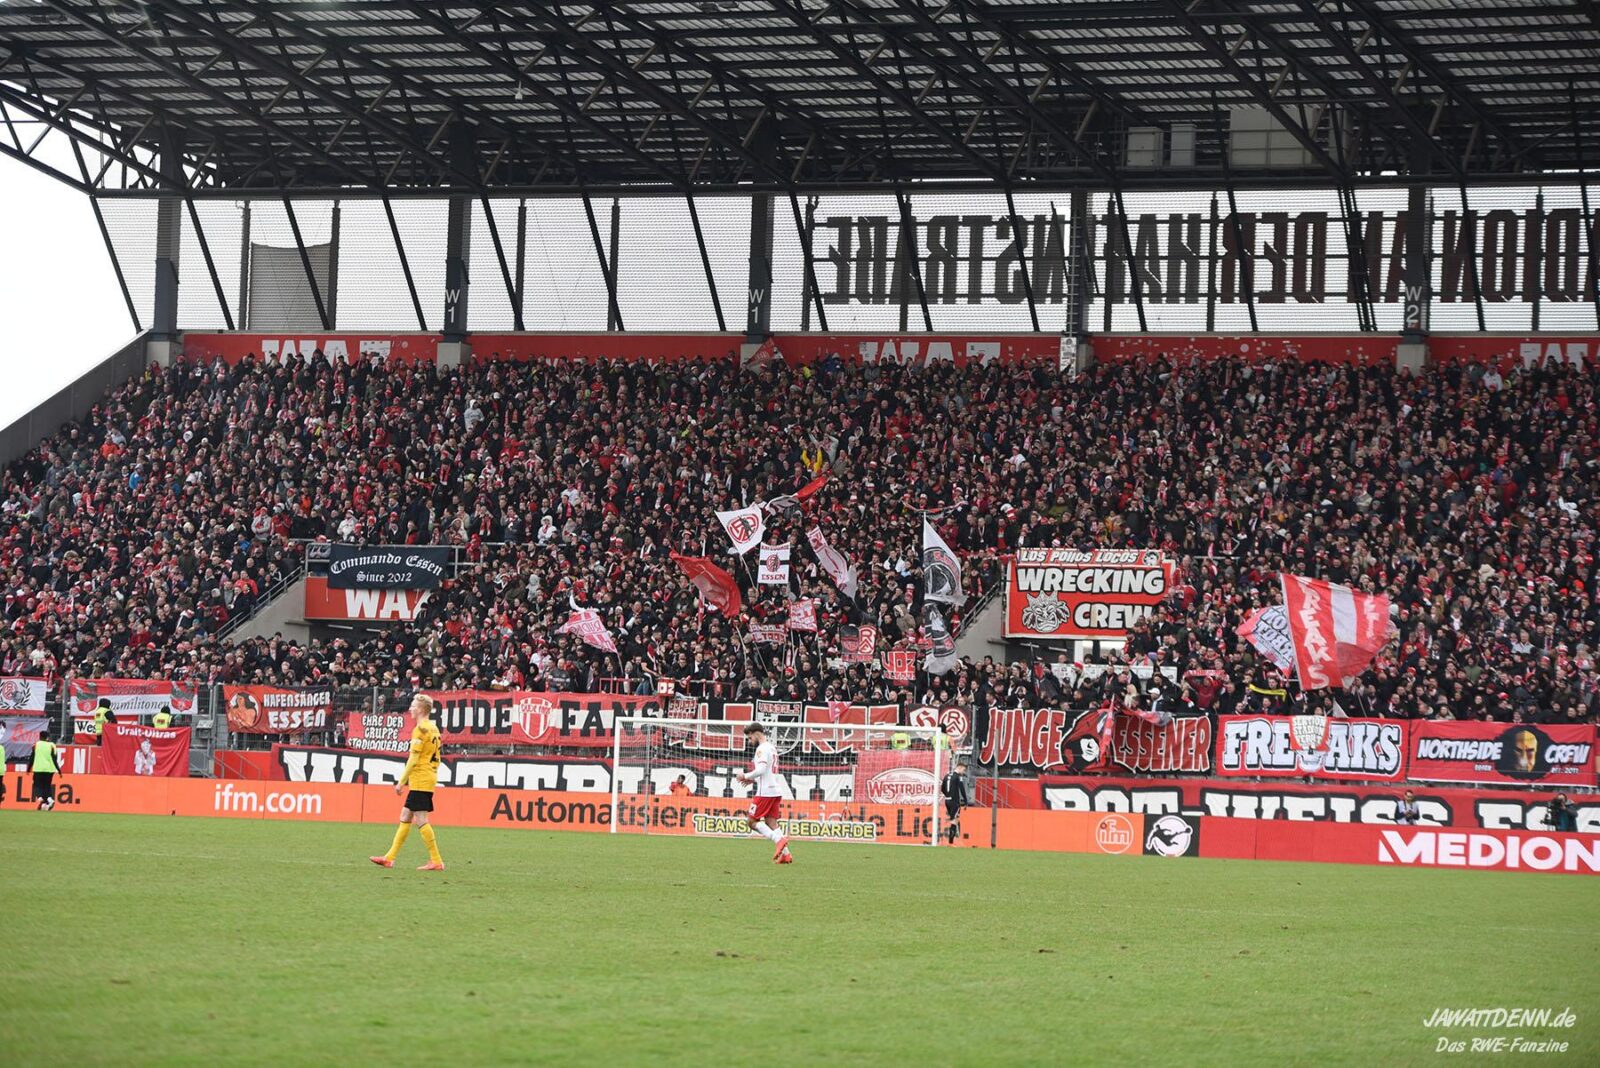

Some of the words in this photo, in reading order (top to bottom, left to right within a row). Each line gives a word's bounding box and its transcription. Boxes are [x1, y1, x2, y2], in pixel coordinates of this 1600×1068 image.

[446, 289, 460, 303] W
[749, 289, 764, 303] W
[1405, 286, 1422, 301] W
[448, 306, 455, 323] 1
[752, 306, 759, 323] 1
[1407, 304, 1420, 322] 2
[330, 553, 402, 575] Commando
[405, 555, 444, 577] Essen
[1022, 550, 1047, 563] LOS
[1095, 551, 1139, 564] LOCOS
[356, 571, 385, 583] Since
[387, 571, 413, 583] 2012
[1016, 567, 1166, 595] WRECKING
[1073, 602, 1153, 630] CREW
[881, 650, 916, 673] UDZ
[263, 691, 331, 708] HAFENSÄNGER
[268, 709, 327, 729] ESSEN
[362, 715, 383, 727] EHRE
[386, 716, 404, 728] DER
[559, 700, 660, 737] FANS
[364, 727, 398, 739] GRUPPE
[979, 707, 1067, 769] JUNGE
[1113, 715, 1212, 773] ESSENER
[1223, 718, 1402, 776] FREAKS
[1417, 739, 1503, 760] NORTHSIDE
[1544, 744, 1590, 764] CREW
[214, 784, 322, 813] ifm.com
[694, 815, 875, 838] TEAMSTBEDARF.DE
[1100, 819, 1129, 845] ifm
[1378, 830, 1600, 872] MEDION
